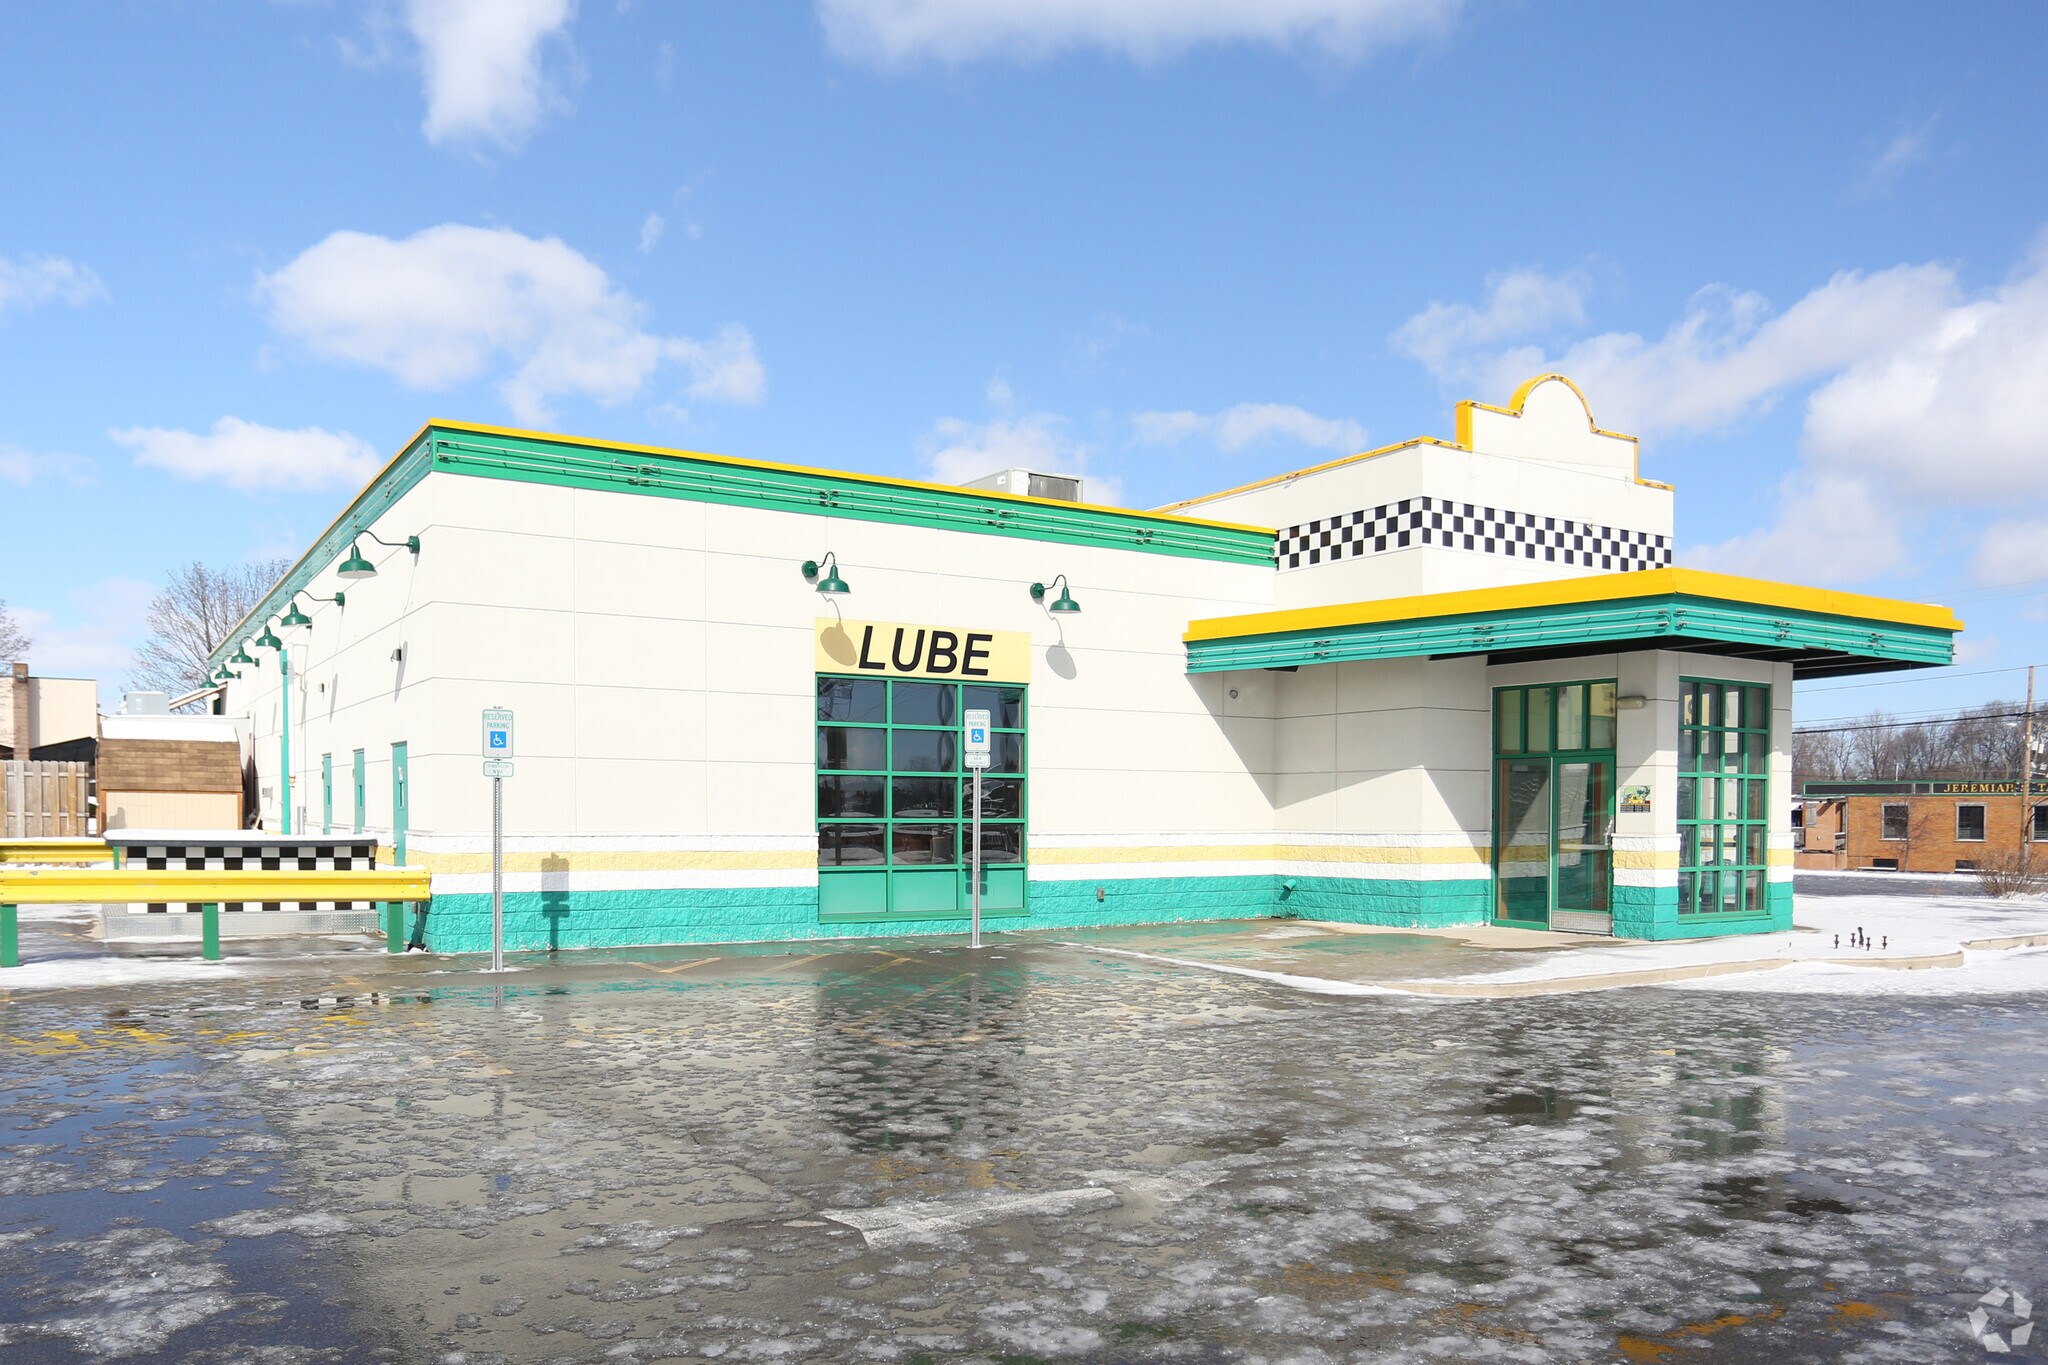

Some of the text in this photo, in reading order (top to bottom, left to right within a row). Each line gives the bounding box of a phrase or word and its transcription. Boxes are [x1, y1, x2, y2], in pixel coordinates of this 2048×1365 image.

[858, 625, 993, 677] LUBE
[483, 713, 513, 721] RESERVED
[486, 722, 510, 730] PARKING
